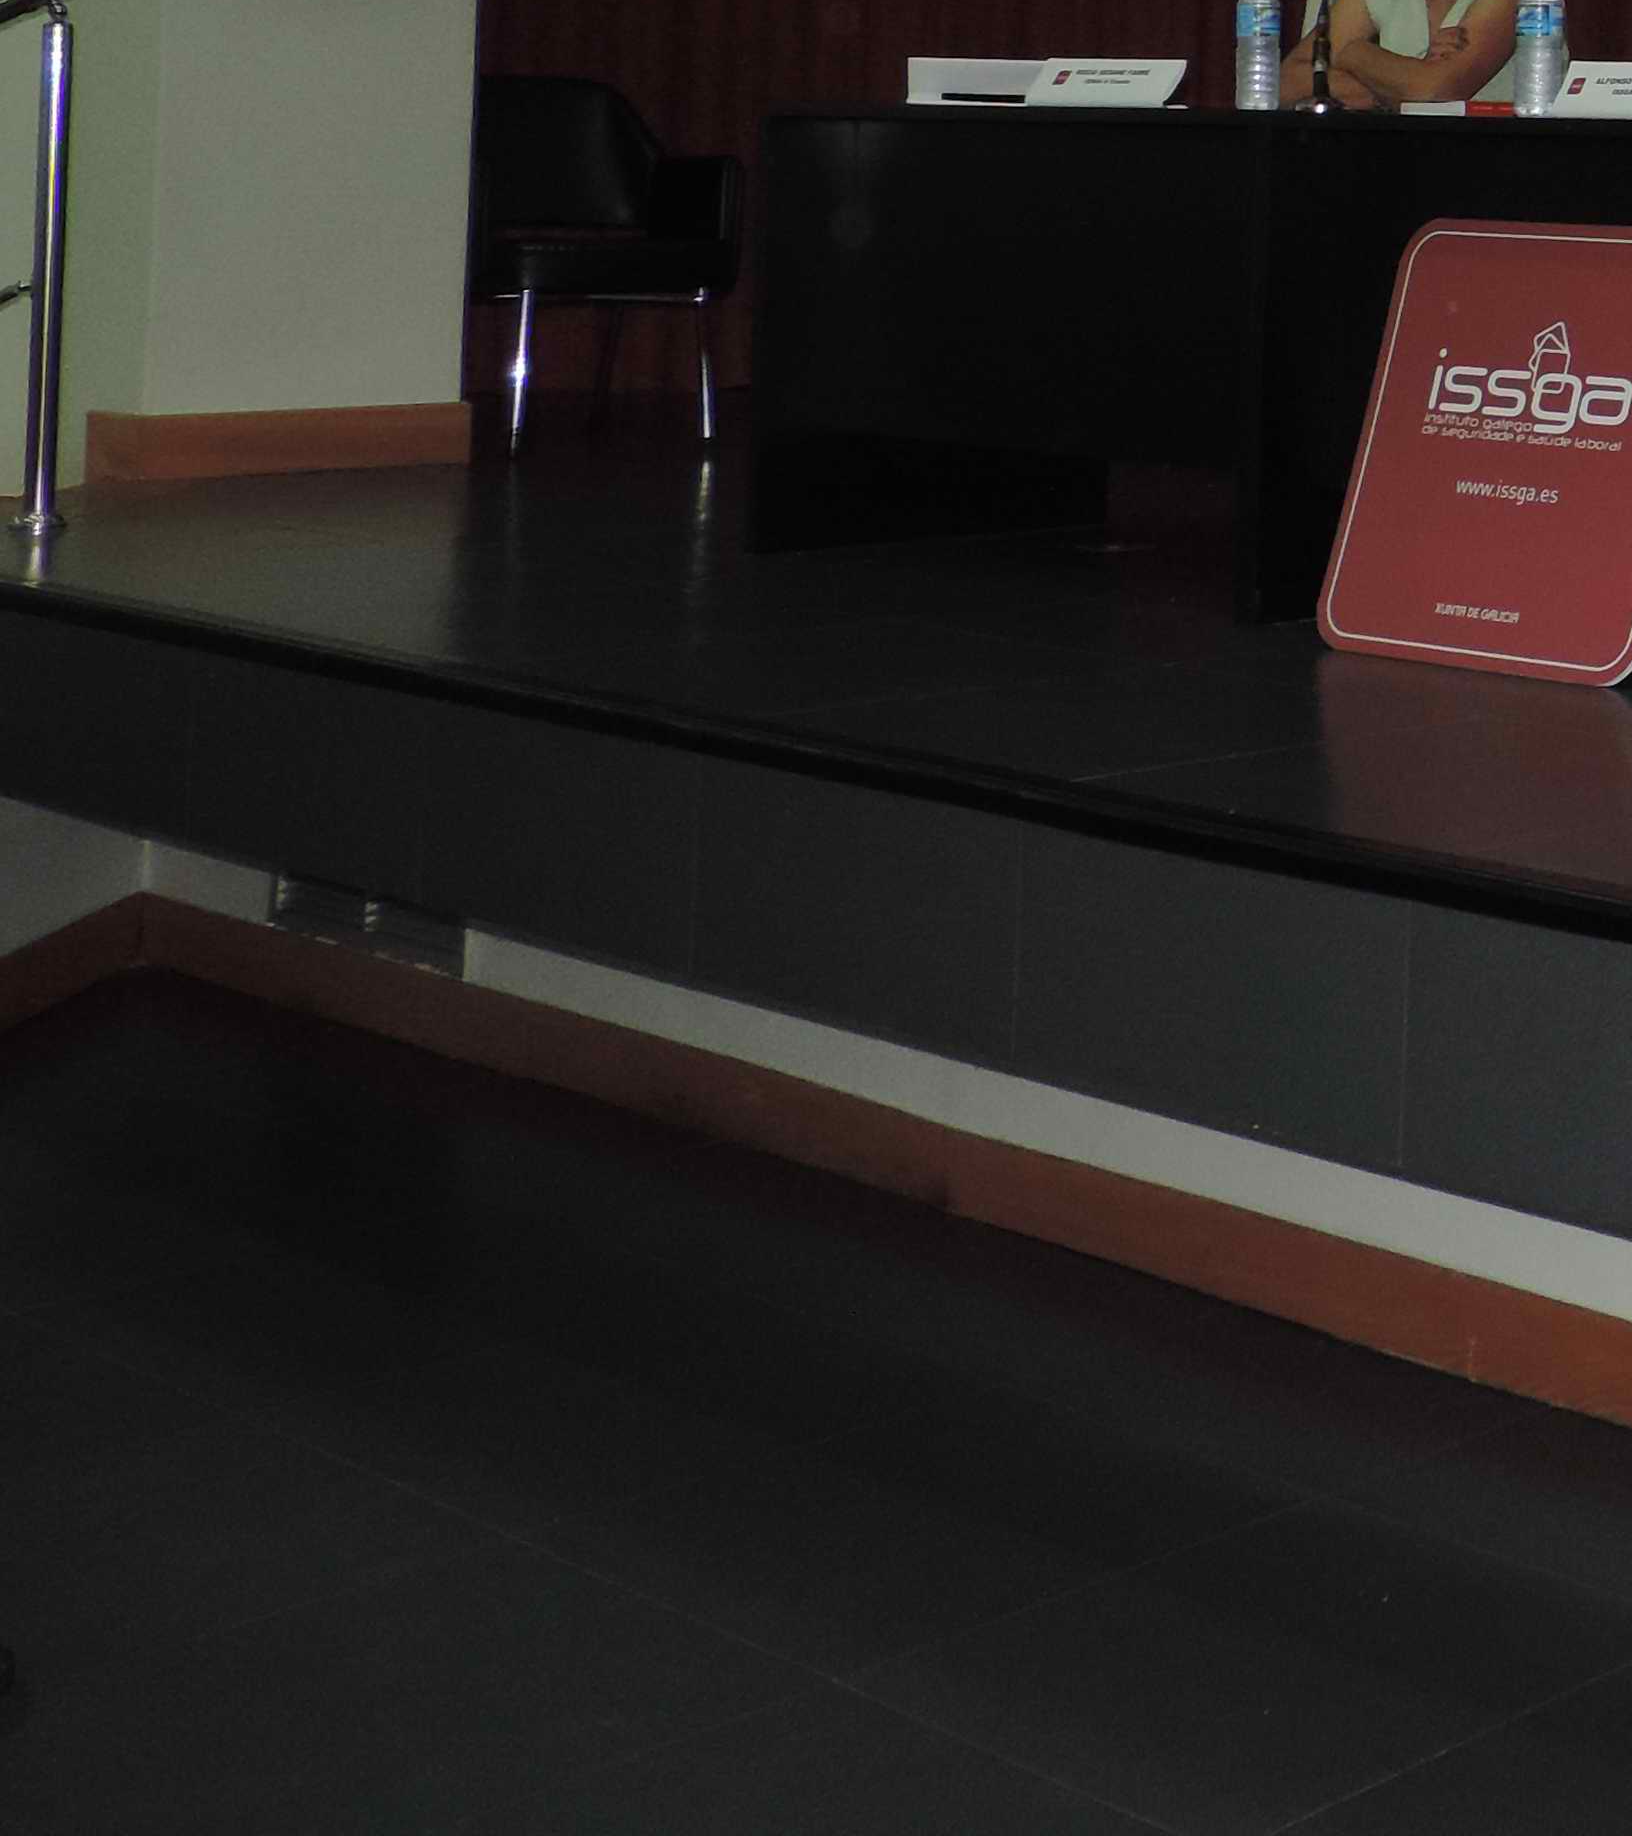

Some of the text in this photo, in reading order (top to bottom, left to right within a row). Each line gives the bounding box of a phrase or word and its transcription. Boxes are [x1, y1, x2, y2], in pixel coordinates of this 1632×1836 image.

[1596, 77, 1632, 85] ALFONSO
[1420, 424, 1439, 436] de
[1455, 478, 1560, 506] www.issga.es
